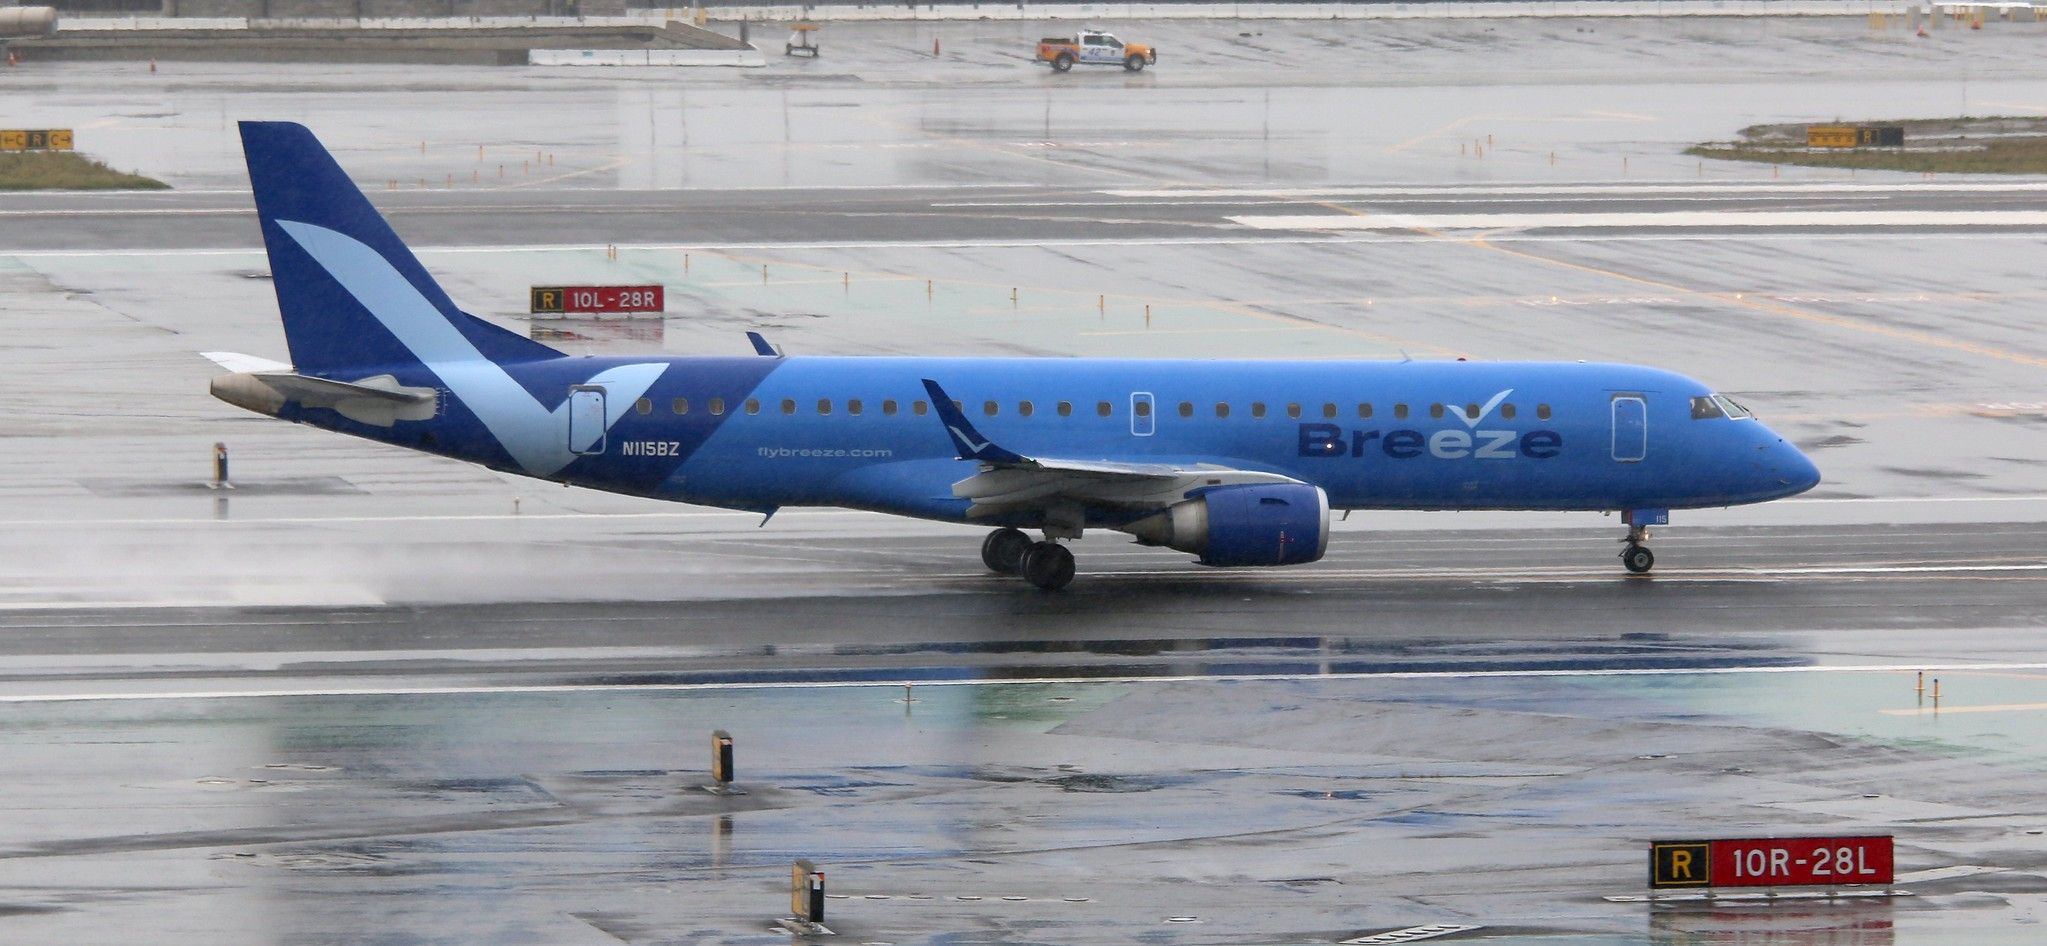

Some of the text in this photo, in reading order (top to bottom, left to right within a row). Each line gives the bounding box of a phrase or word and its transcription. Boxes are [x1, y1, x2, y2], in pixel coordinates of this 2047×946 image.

[543, 292, 554, 308] R
[1298, 422, 1563, 459] Breeze
[622, 441, 680, 457] N115BZ
[757, 446, 892, 459] flybreeze.com
[1655, 514, 1667, 523] 115
[1671, 846, 1876, 879] R 10R-28L
